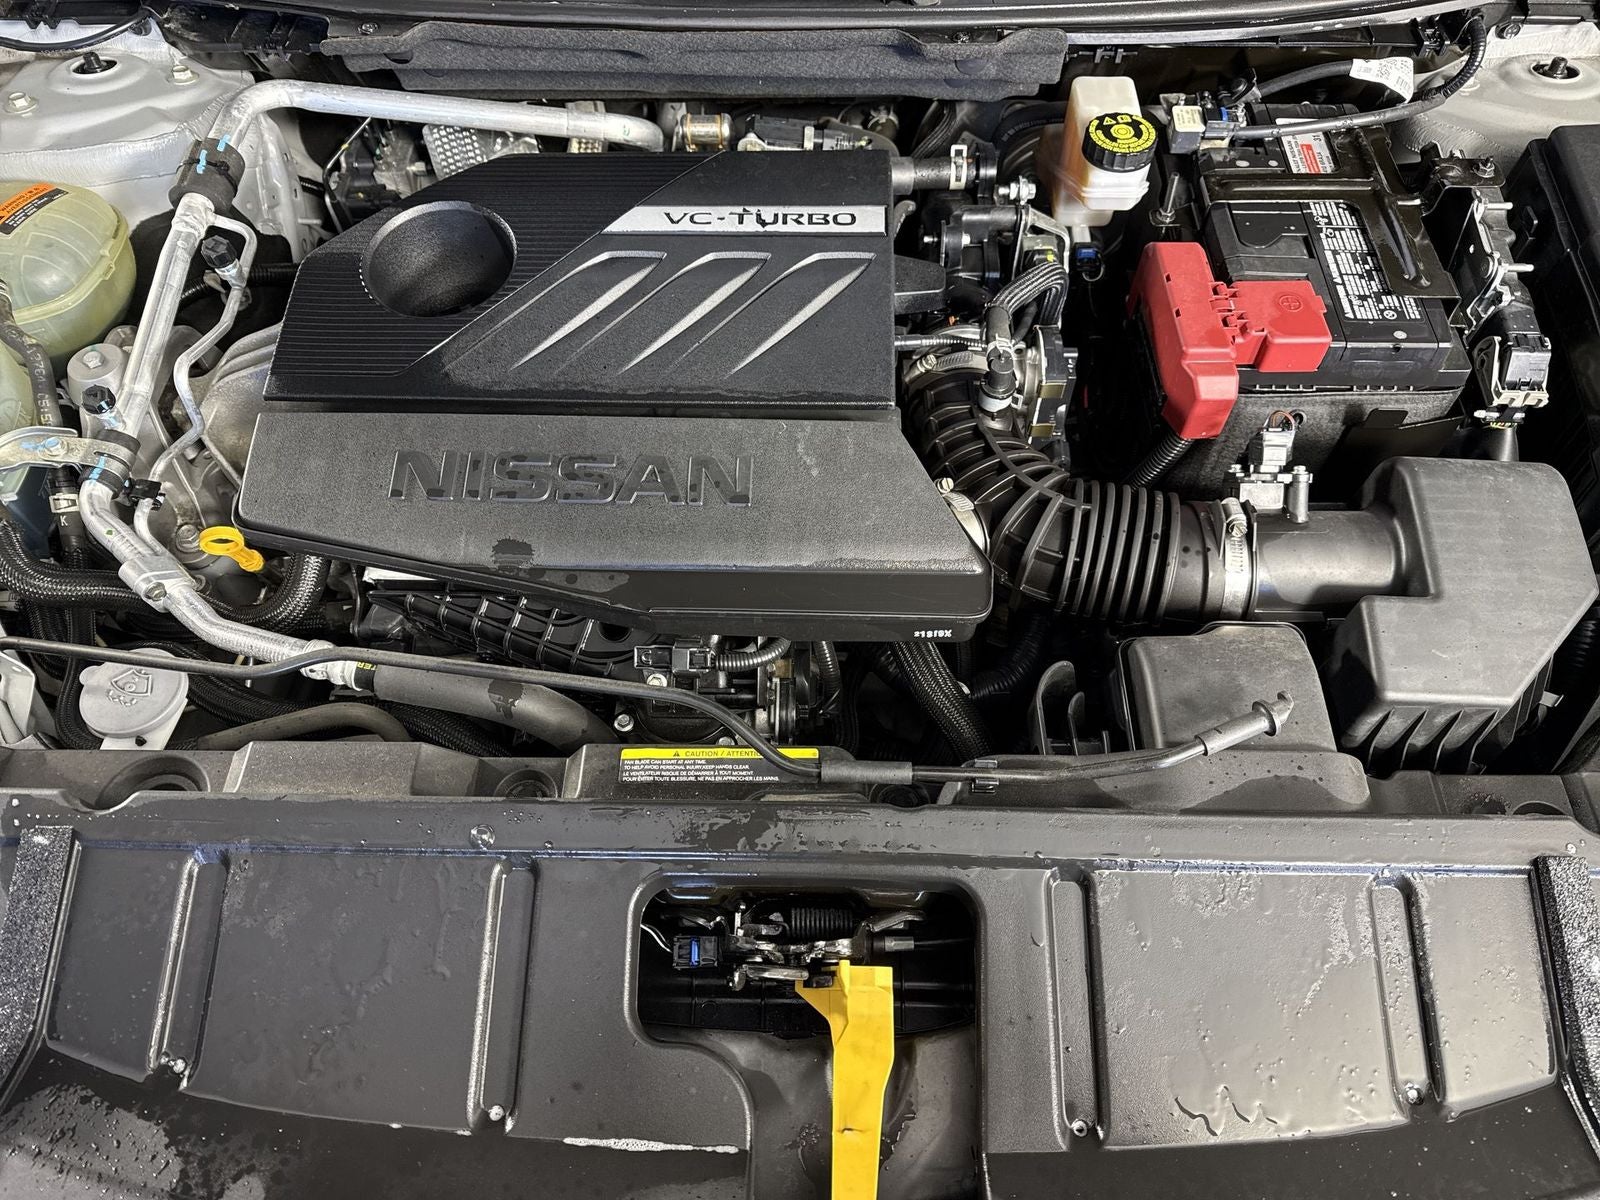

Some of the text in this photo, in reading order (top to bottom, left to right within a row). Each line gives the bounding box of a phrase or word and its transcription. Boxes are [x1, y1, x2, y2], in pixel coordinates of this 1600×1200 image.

[664, 208, 857, 228] VC-TURBO
[387, 450, 752, 506] NISSAN
[60, 515, 68, 526] K
